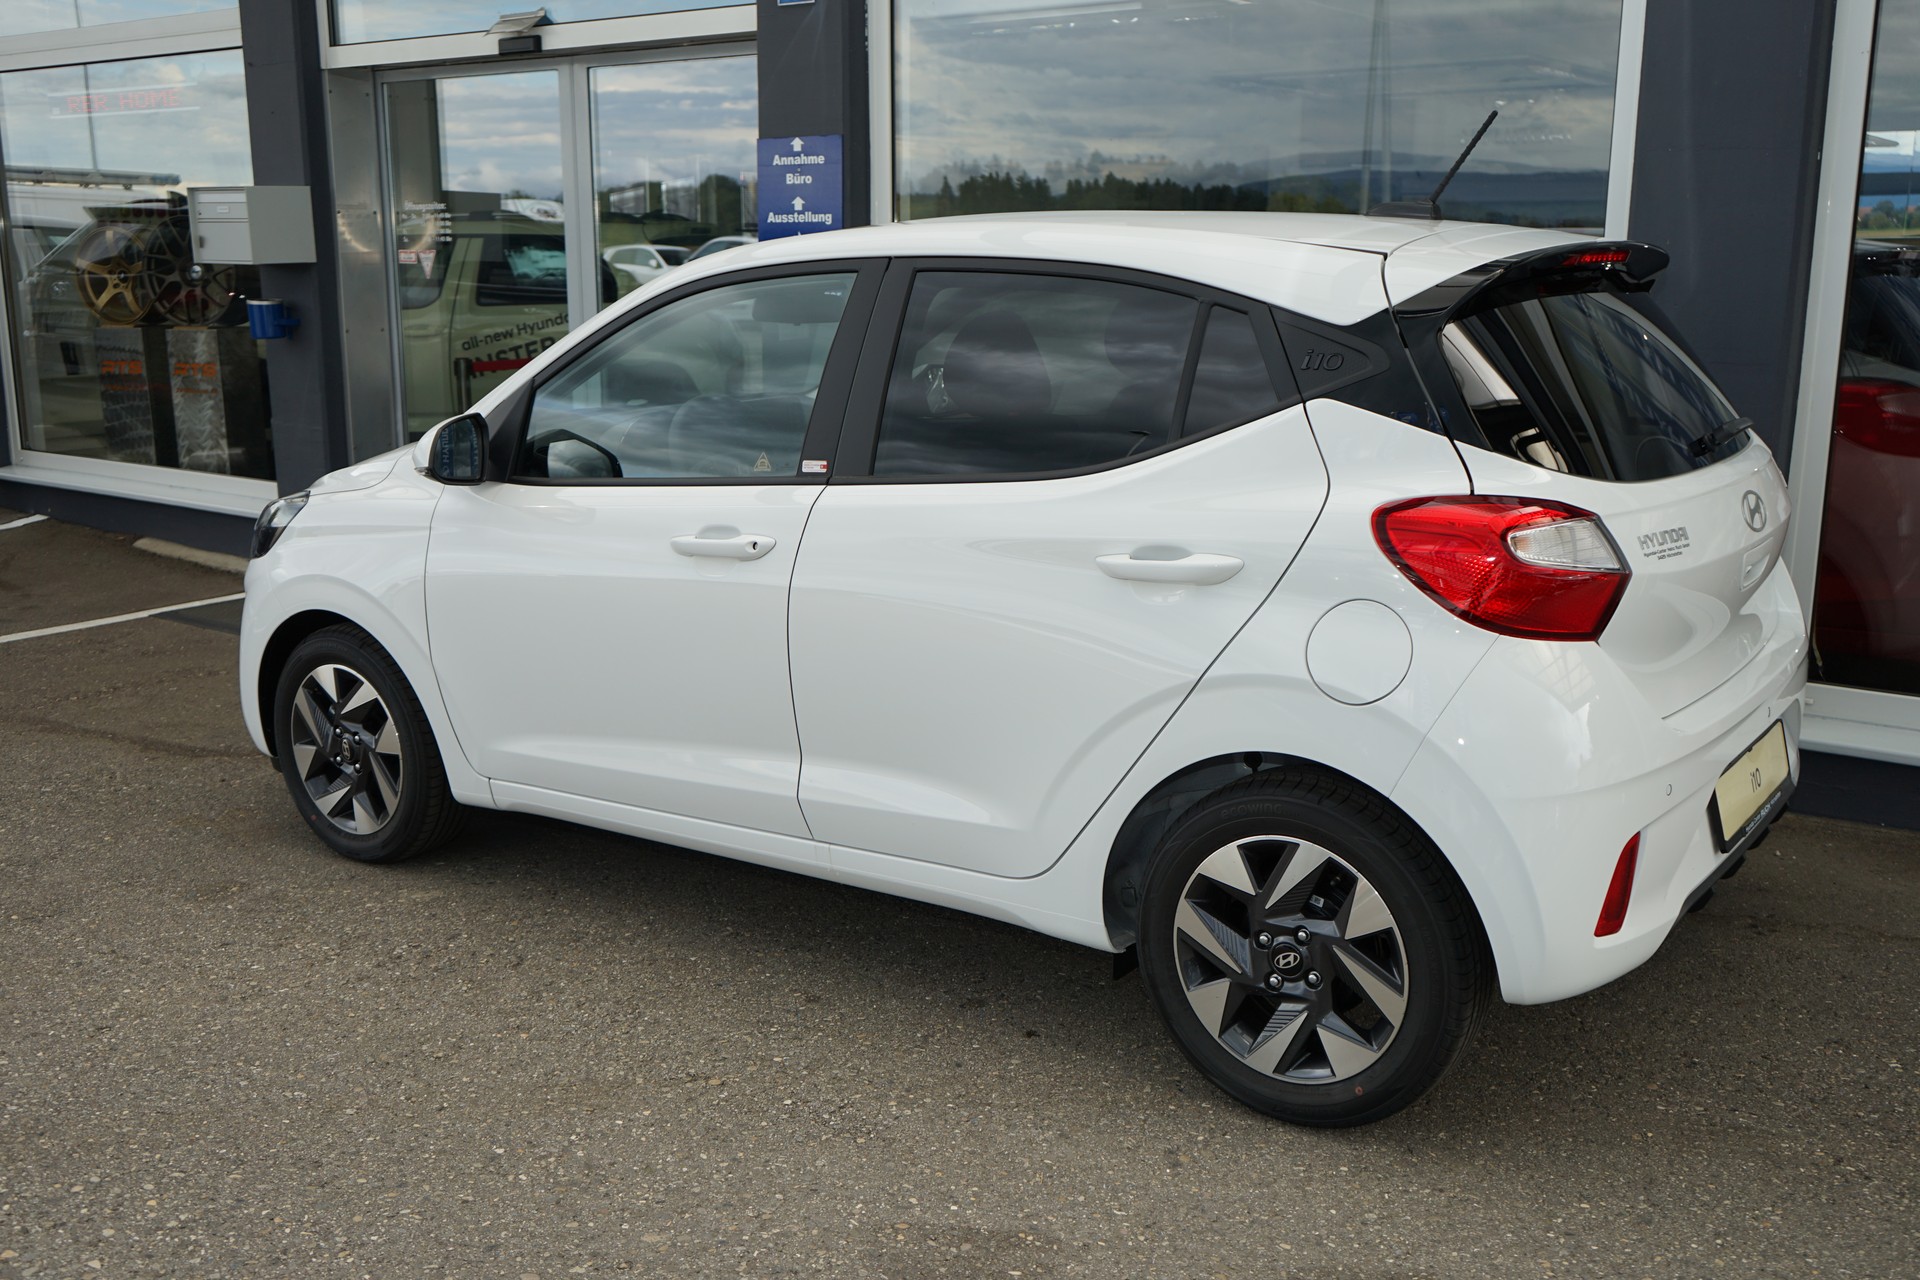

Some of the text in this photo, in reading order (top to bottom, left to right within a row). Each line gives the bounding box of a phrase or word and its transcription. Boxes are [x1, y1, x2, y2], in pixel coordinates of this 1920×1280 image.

[772, 153, 825, 166] Annahme
[785, 172, 812, 185] Büro
[767, 211, 832, 225] Ausstellung
[462, 327, 514, 351] all-new
[1300, 348, 1345, 371] i10
[1636, 526, 1690, 551] HYUNDAI
[1749, 767, 1762, 793] i10
